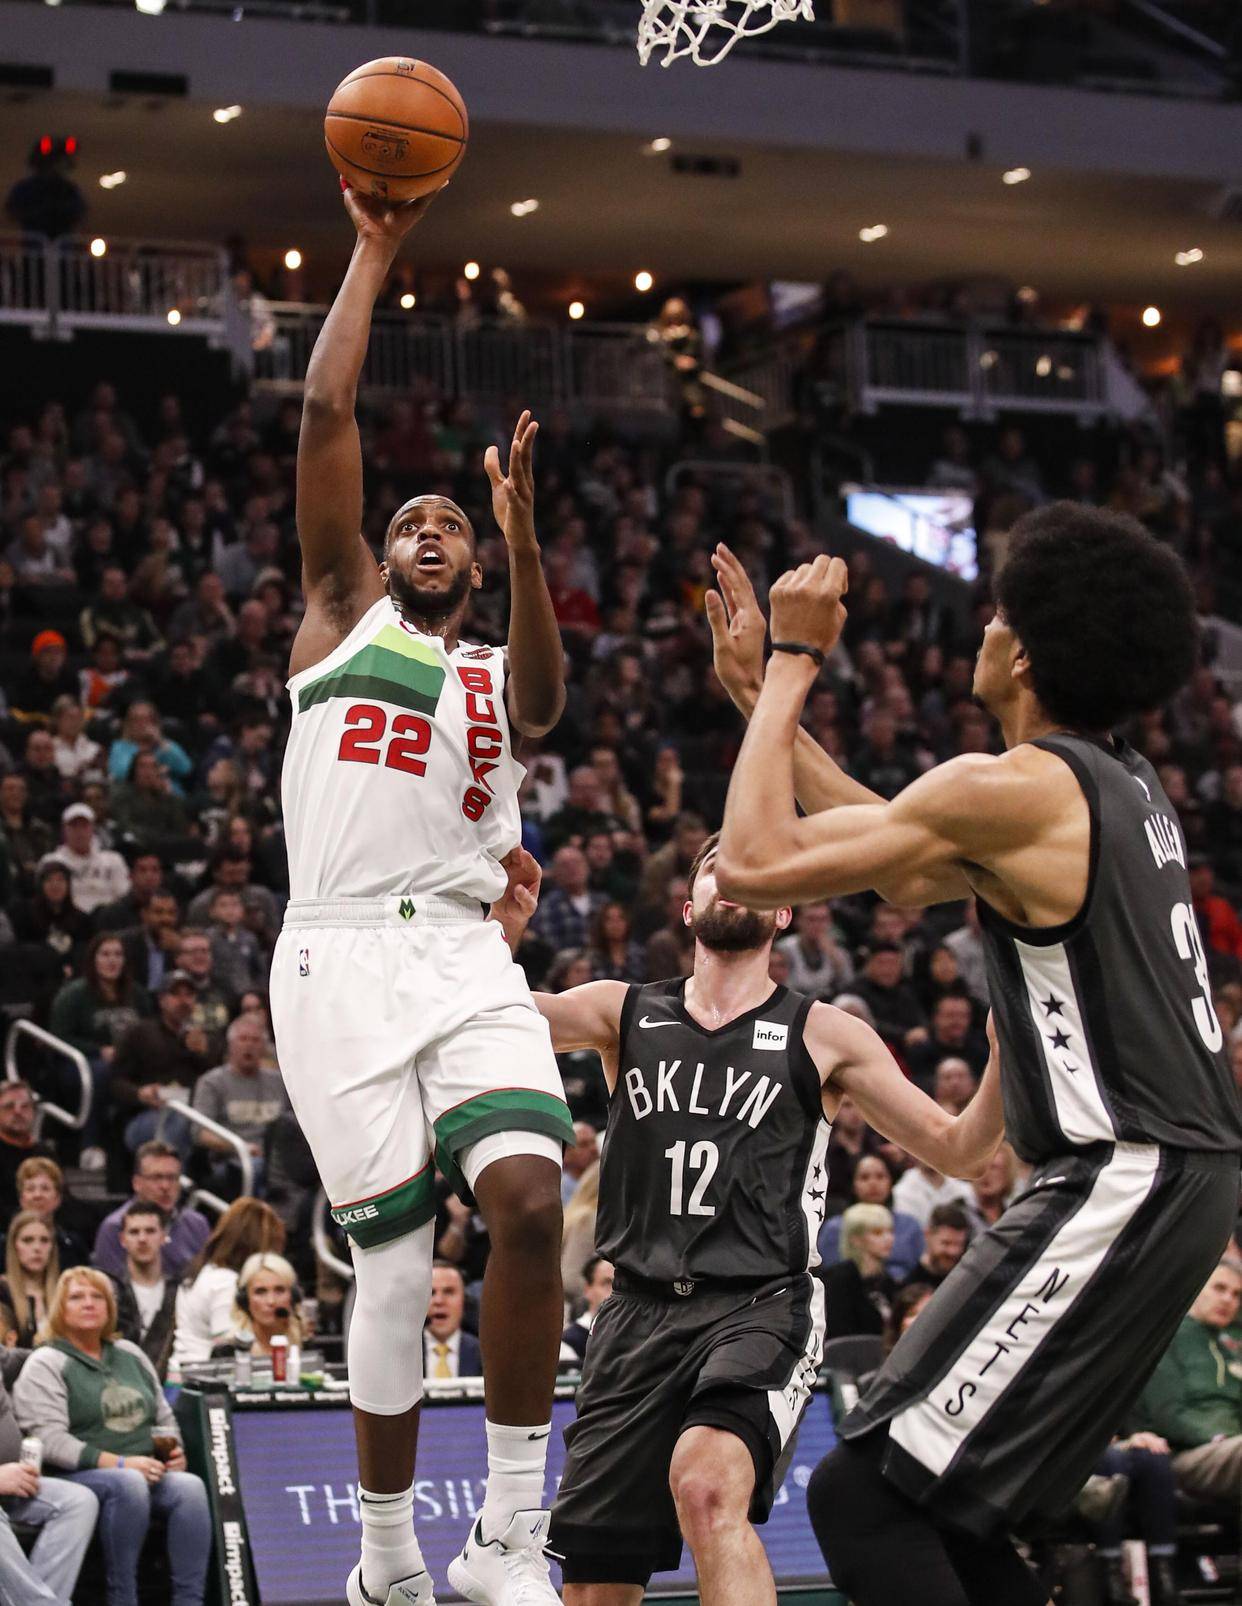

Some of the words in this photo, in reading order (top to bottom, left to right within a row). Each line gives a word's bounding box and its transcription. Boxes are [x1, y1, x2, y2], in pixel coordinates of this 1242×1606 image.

[337, 703, 433, 778] 22
[457, 666, 503, 823] BUCKS
[1170, 902, 1224, 1054] 3
[756, 1029, 785, 1042] infor
[625, 1059, 783, 1129] BKLYN
[664, 1140, 720, 1216] 12
[944, 1267, 1070, 1416] NETS
[285, 1483, 360, 1525] TH
